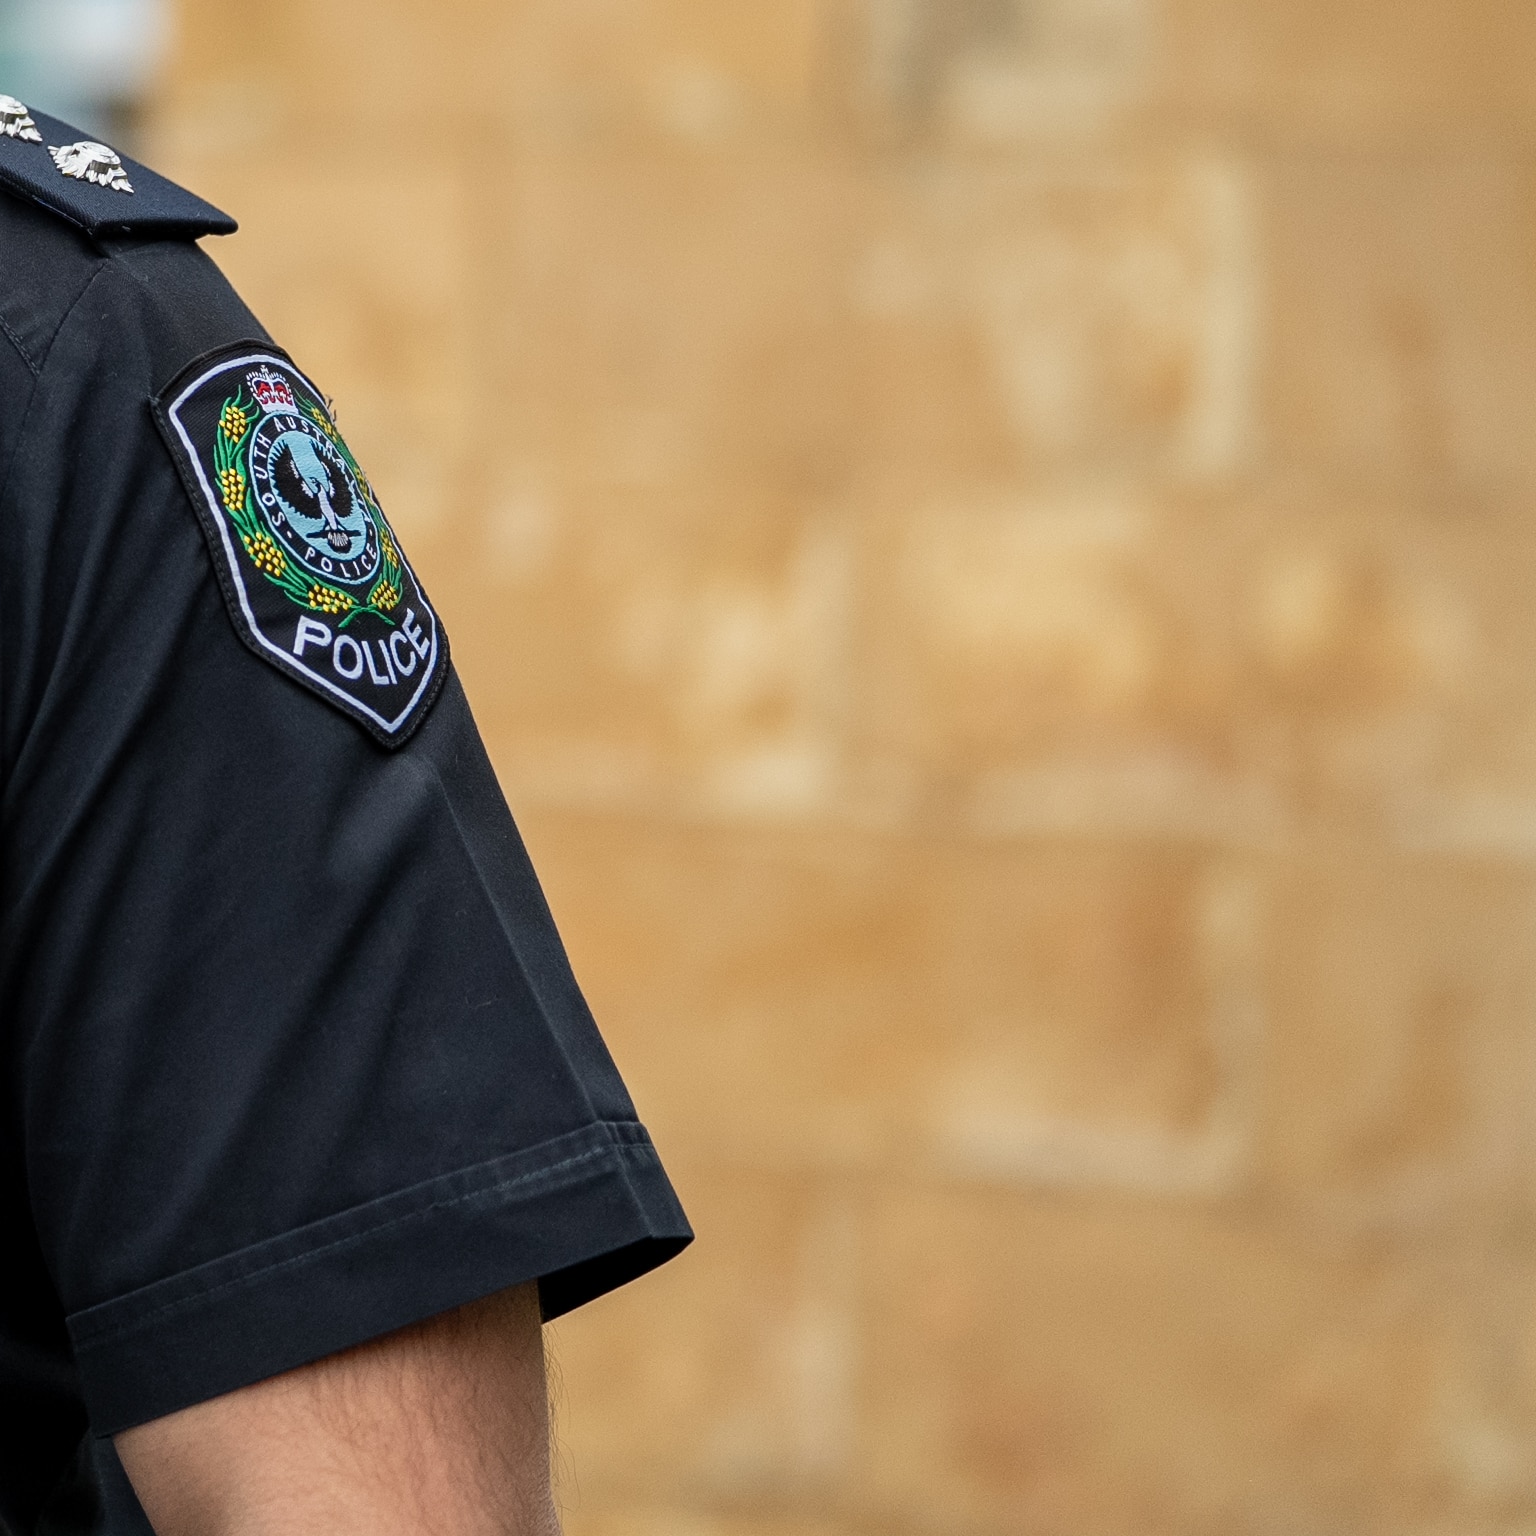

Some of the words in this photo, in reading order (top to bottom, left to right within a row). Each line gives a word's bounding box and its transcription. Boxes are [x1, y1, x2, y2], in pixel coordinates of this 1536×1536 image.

[253, 436, 286, 526] SOUTH
[304, 546, 378, 578] POLICE
[293, 609, 430, 685] POLICE
